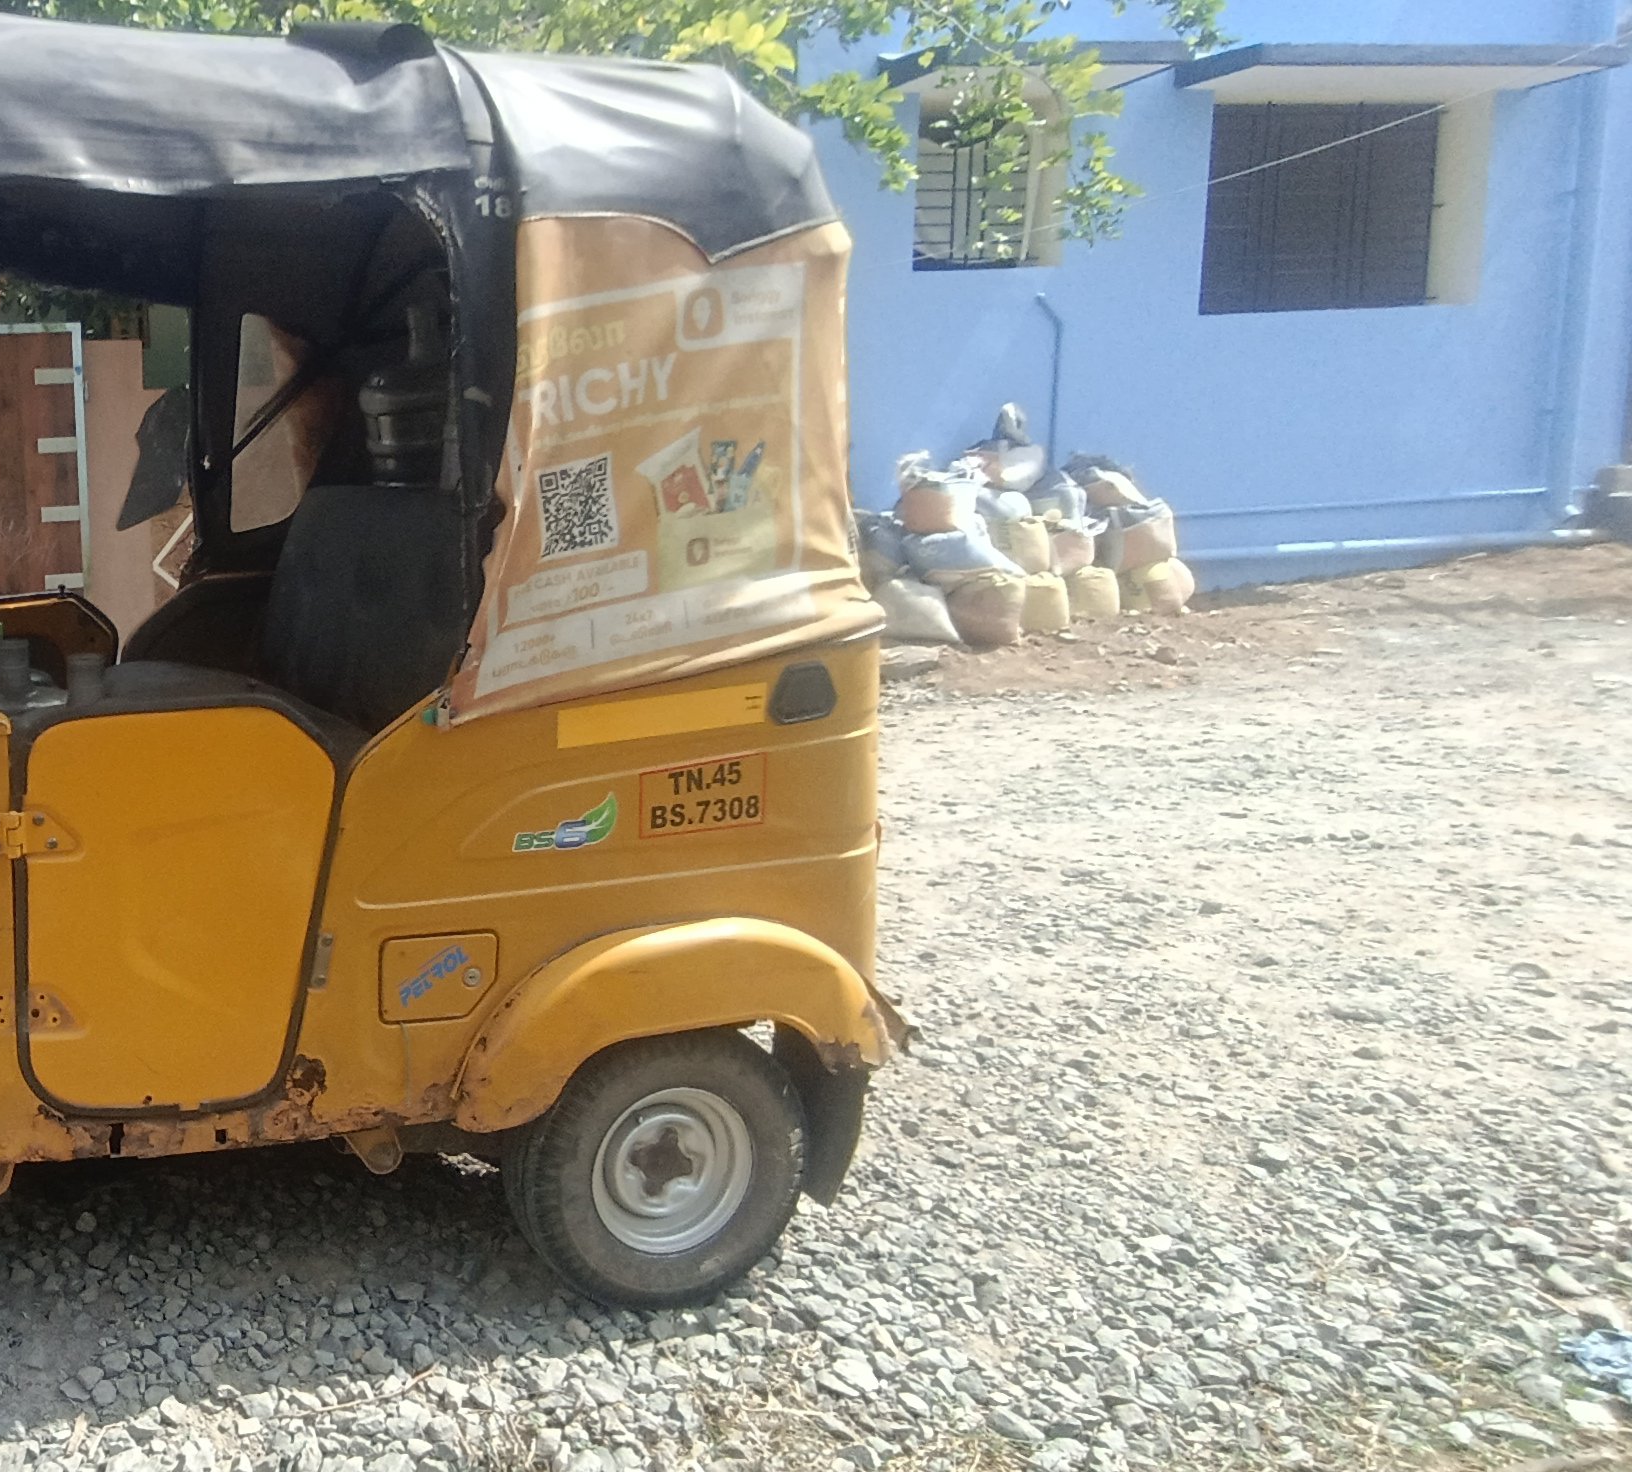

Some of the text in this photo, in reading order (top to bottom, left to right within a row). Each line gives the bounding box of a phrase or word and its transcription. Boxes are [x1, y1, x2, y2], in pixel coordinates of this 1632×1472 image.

[534, 572, 572, 590] CASH
[576, 556, 640, 582] AVAILABLE
[667, 760, 743, 797] TN.45
[650, 793, 761, 830] BS.7308
[514, 819, 590, 850] BS6
[399, 946, 470, 1008] PETROL
